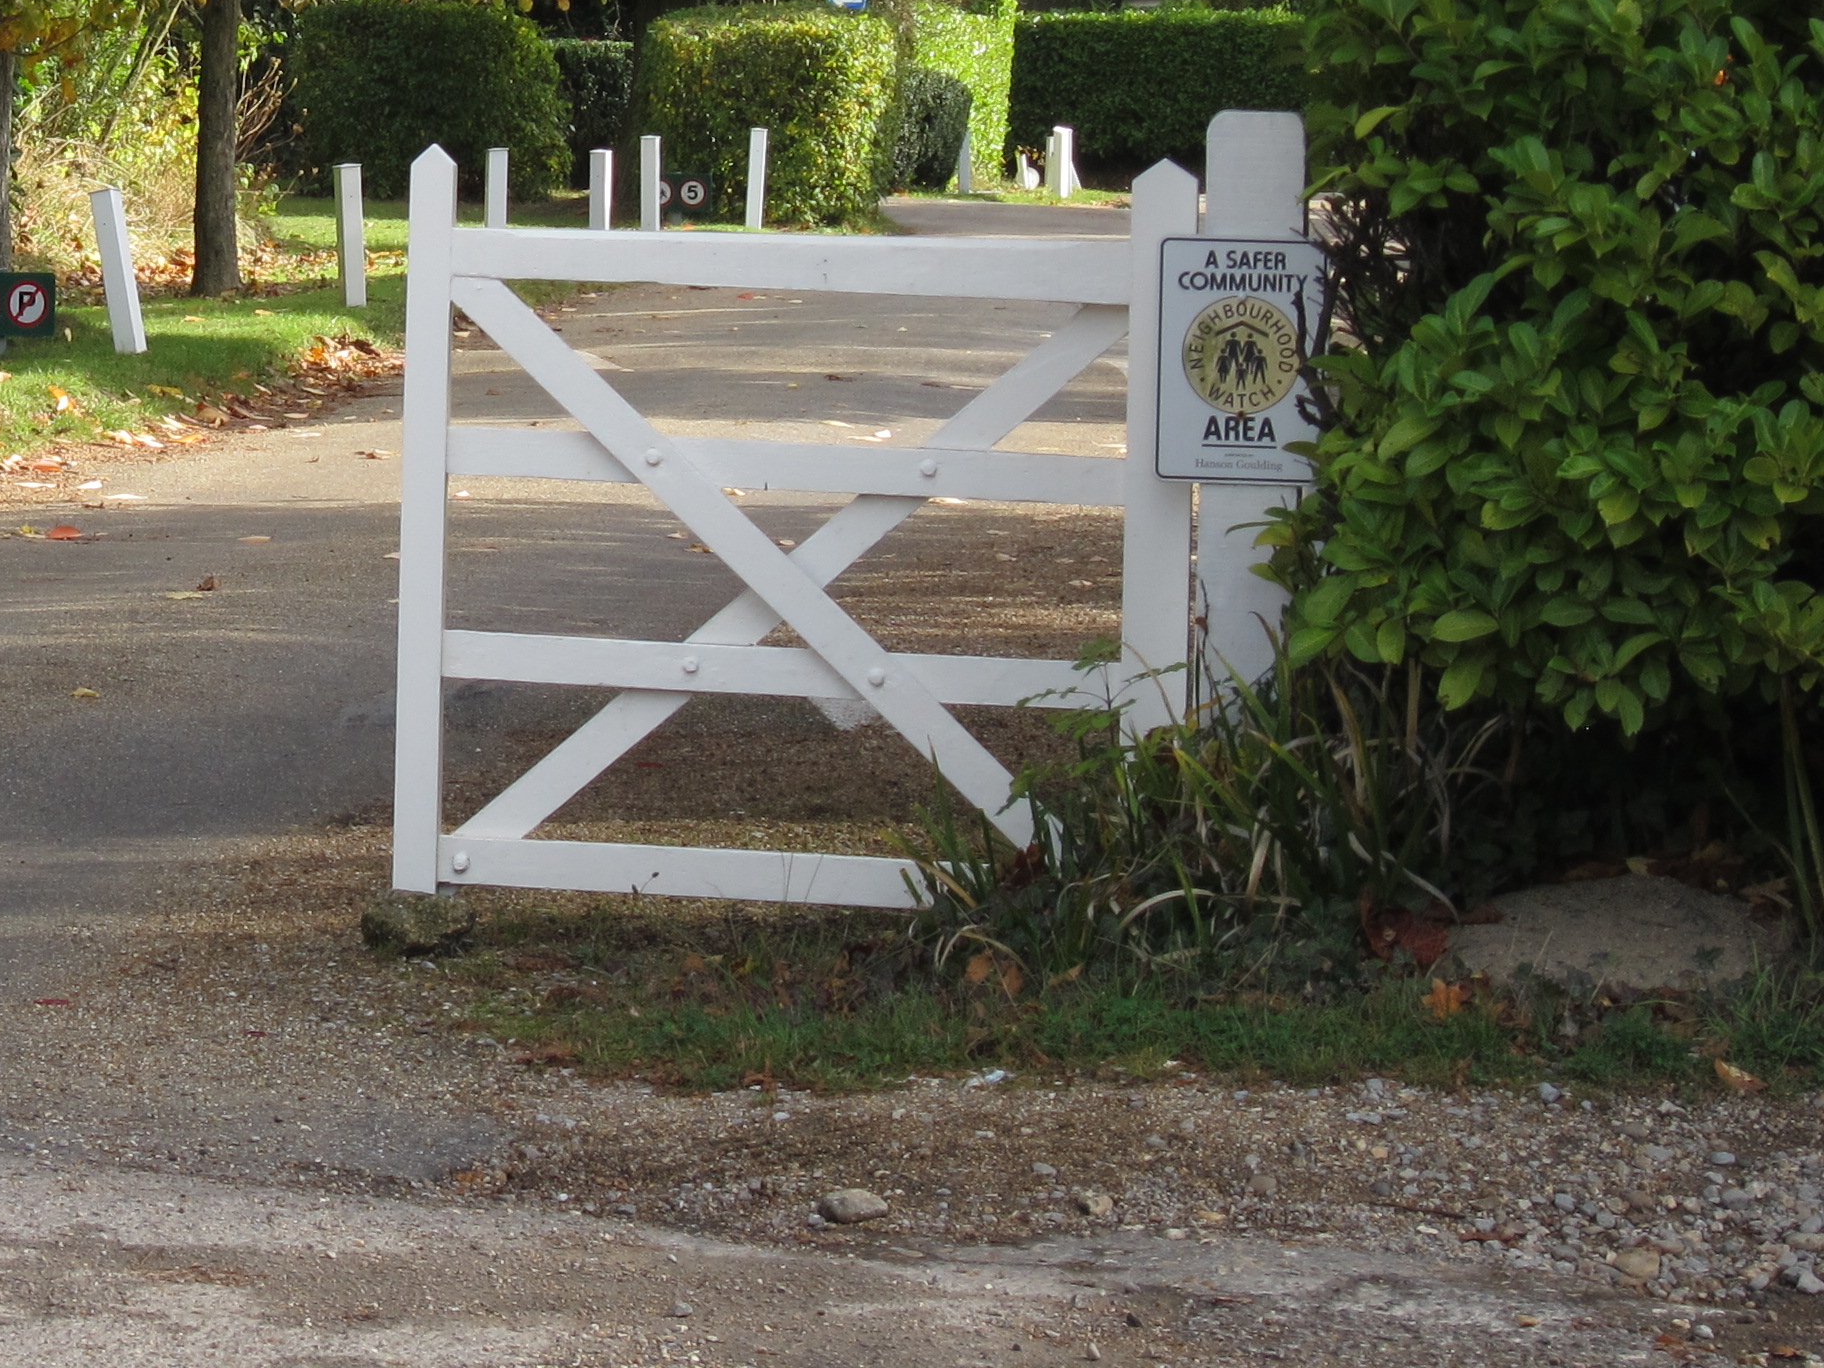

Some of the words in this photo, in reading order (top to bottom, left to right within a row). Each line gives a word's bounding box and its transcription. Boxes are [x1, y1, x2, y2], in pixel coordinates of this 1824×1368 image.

[687, 185, 698, 200] 5
[1205, 250, 1219, 269] A
[1226, 250, 1287, 271] SAFER
[1178, 271, 1308, 293] COMMUNITY
[1188, 302, 1295, 373] NEIGHBOURHOOD
[1208, 384, 1276, 410] WATCH
[1203, 415, 1277, 444] AREA
[1195, 458, 1233, 470] Hanson
[1236, 460, 1283, 472] Goulding
